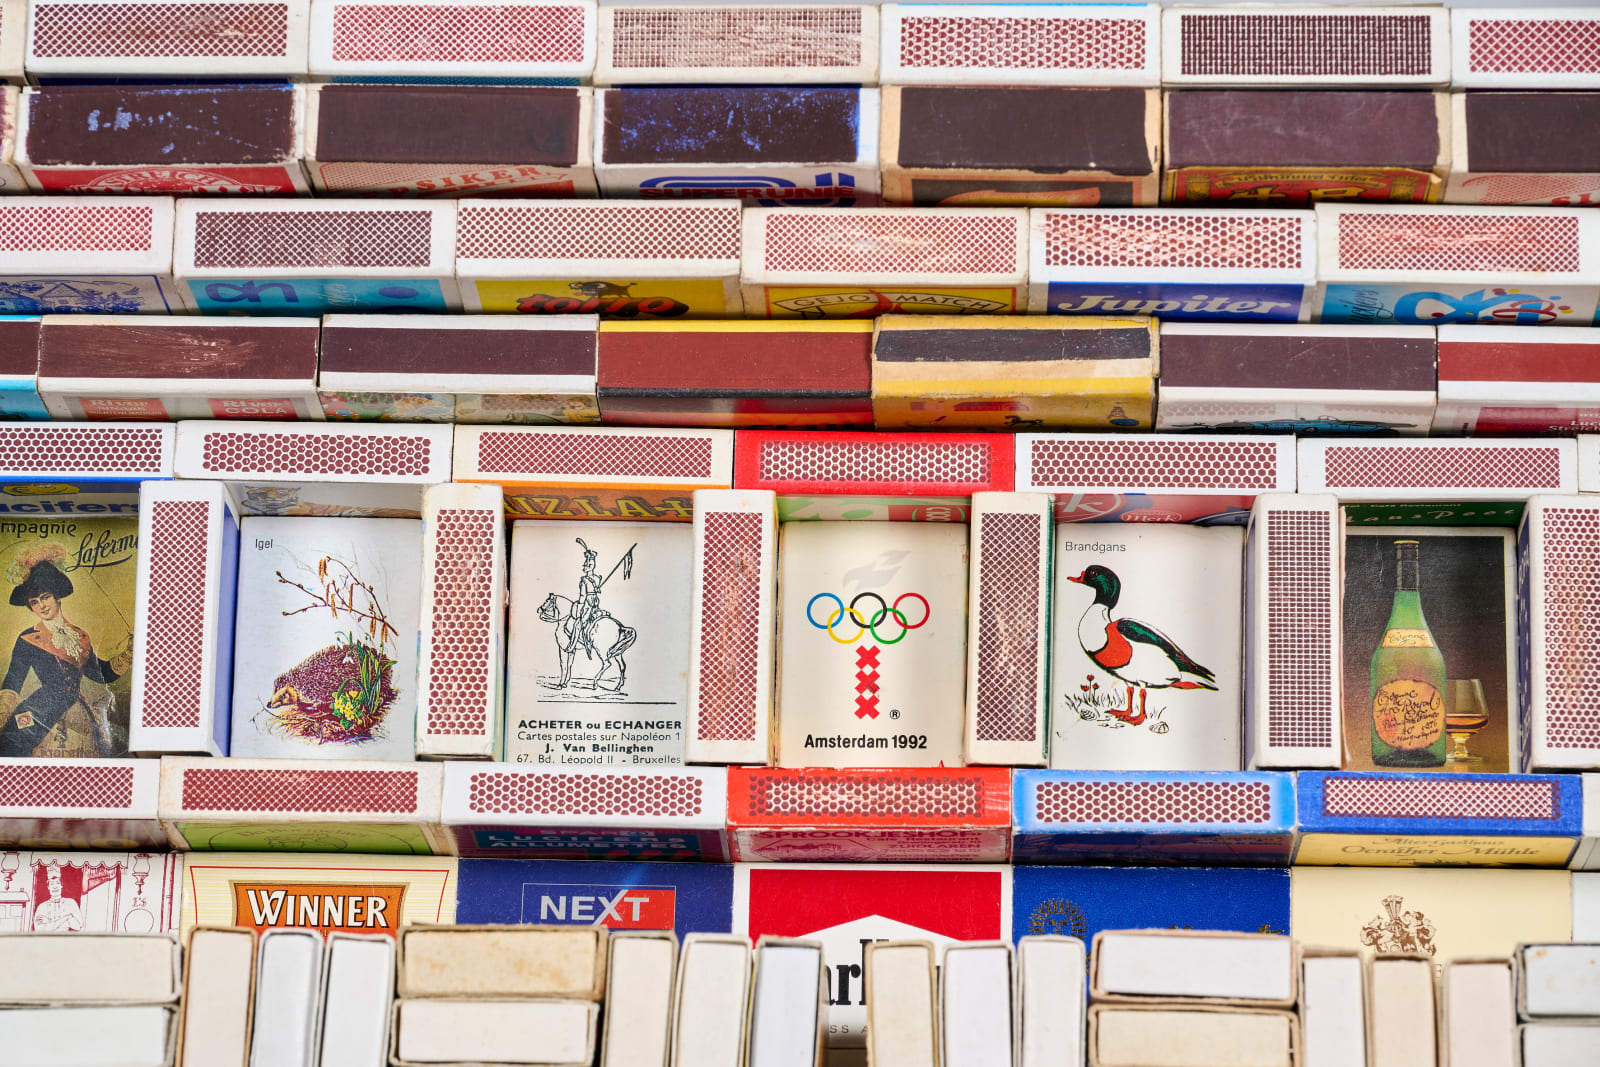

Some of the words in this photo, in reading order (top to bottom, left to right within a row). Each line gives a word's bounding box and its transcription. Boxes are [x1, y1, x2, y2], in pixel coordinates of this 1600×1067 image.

[793, 293, 870, 307] GEJO
[898, 294, 992, 311] MATCH
[1057, 294, 1292, 314] Jupiter
[504, 494, 693, 518] IZLA+
[1, 521, 77, 538] mpagnie
[255, 538, 274, 549] Igel
[1065, 541, 1126, 553] Brandgans
[518, 720, 582, 729] ACHETER
[586, 722, 600, 730] ou
[604, 720, 682, 730] ECHANGER
[517, 731, 552, 741] Cartes
[555, 732, 596, 743] postales
[621, 732, 671, 743] Napoléon
[804, 734, 888, 748] Amsterdam
[892, 734, 928, 749] 1992
[545, 743, 554, 754] J.
[563, 743, 586, 752] Van
[592, 743, 654, 754] Bellinghen
[538, 755, 555, 764] Bd.
[561, 754, 603, 765] Léopold
[632, 755, 681, 764] Bruxelles
[488, 835, 686, 843] LUCIFERS
[246, 889, 389, 928] WINNER
[540, 890, 649, 925] NEXT
